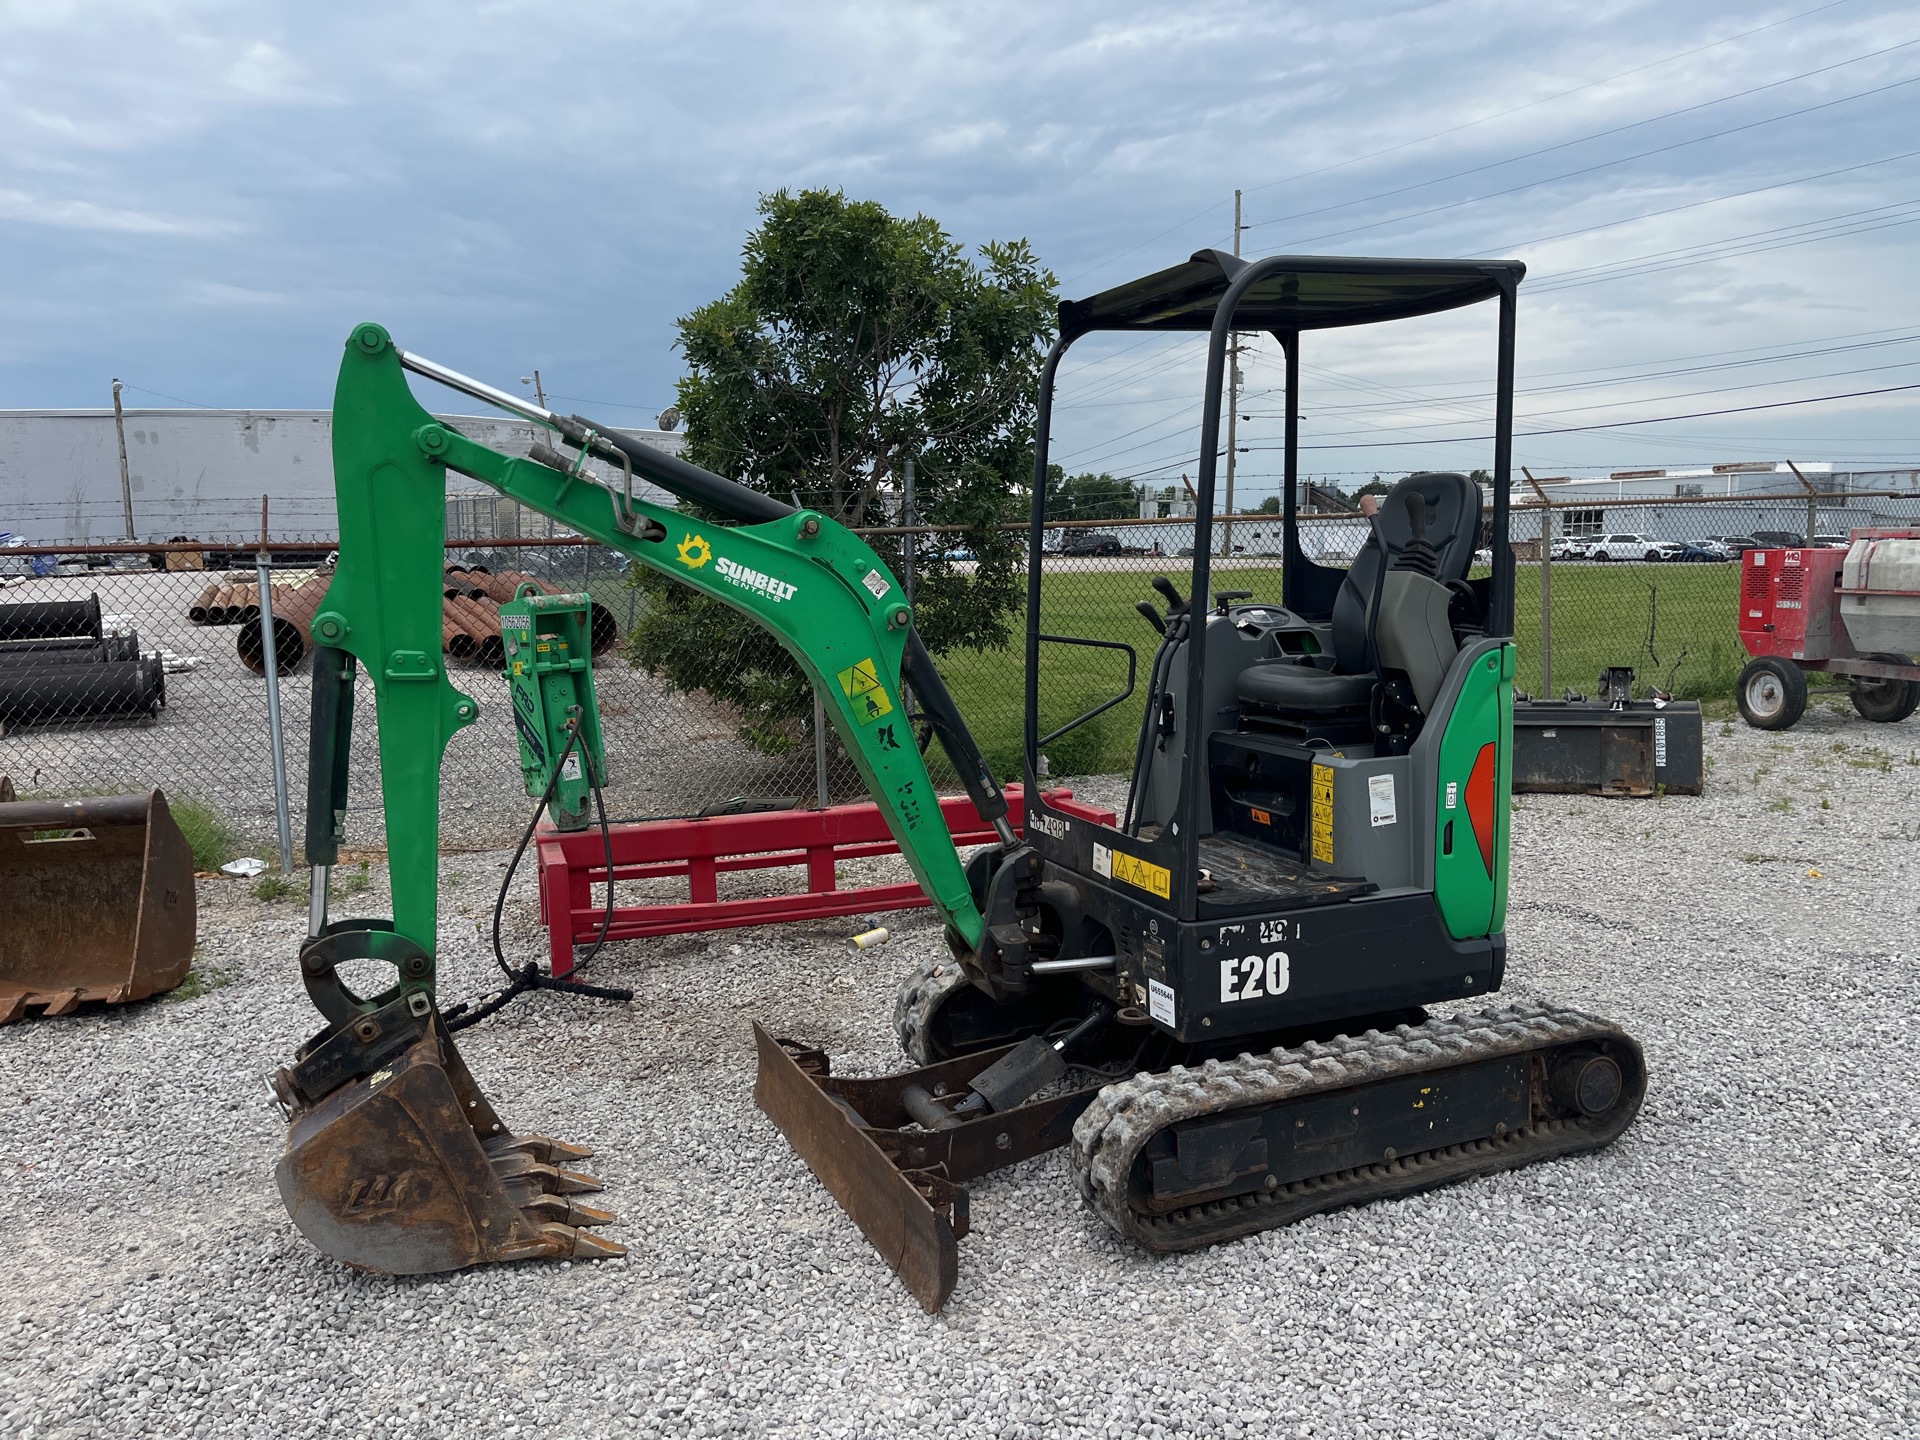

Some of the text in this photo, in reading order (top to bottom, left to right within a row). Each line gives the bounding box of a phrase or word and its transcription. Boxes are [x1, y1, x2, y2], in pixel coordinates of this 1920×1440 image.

[715, 557, 798, 601] SUNBELT
[723, 575, 782, 603] RENTALS
[1655, 718, 1666, 766] 10101885
[1220, 951, 1290, 1003] E20
